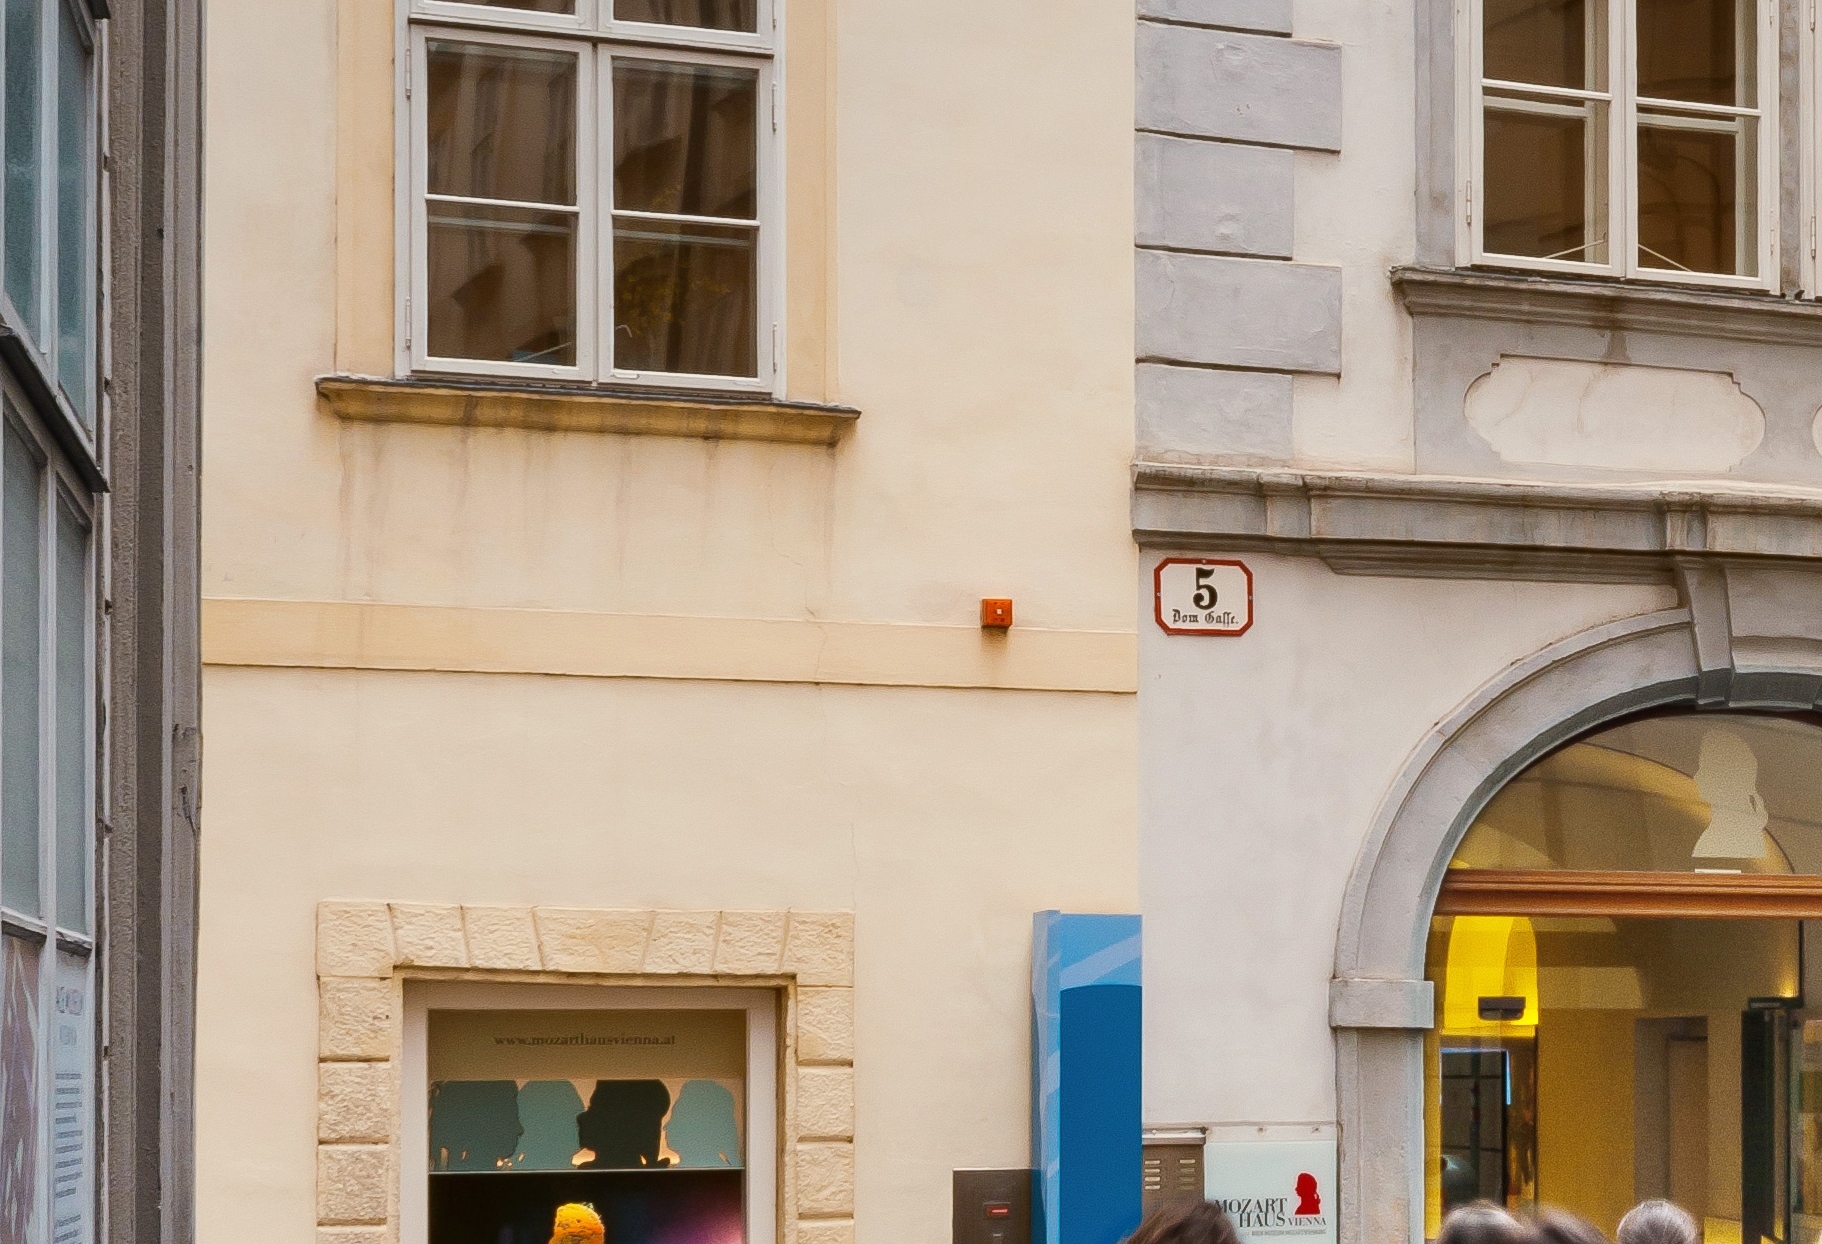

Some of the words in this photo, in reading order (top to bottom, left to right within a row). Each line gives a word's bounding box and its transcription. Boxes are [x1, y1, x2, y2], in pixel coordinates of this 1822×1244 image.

[1192, 566, 1219, 611] 5
[1172, 608, 1200, 624] Dom
[1238, 1211, 1287, 1228] HAUS
[1287, 1216, 1327, 1227] VIENNA
